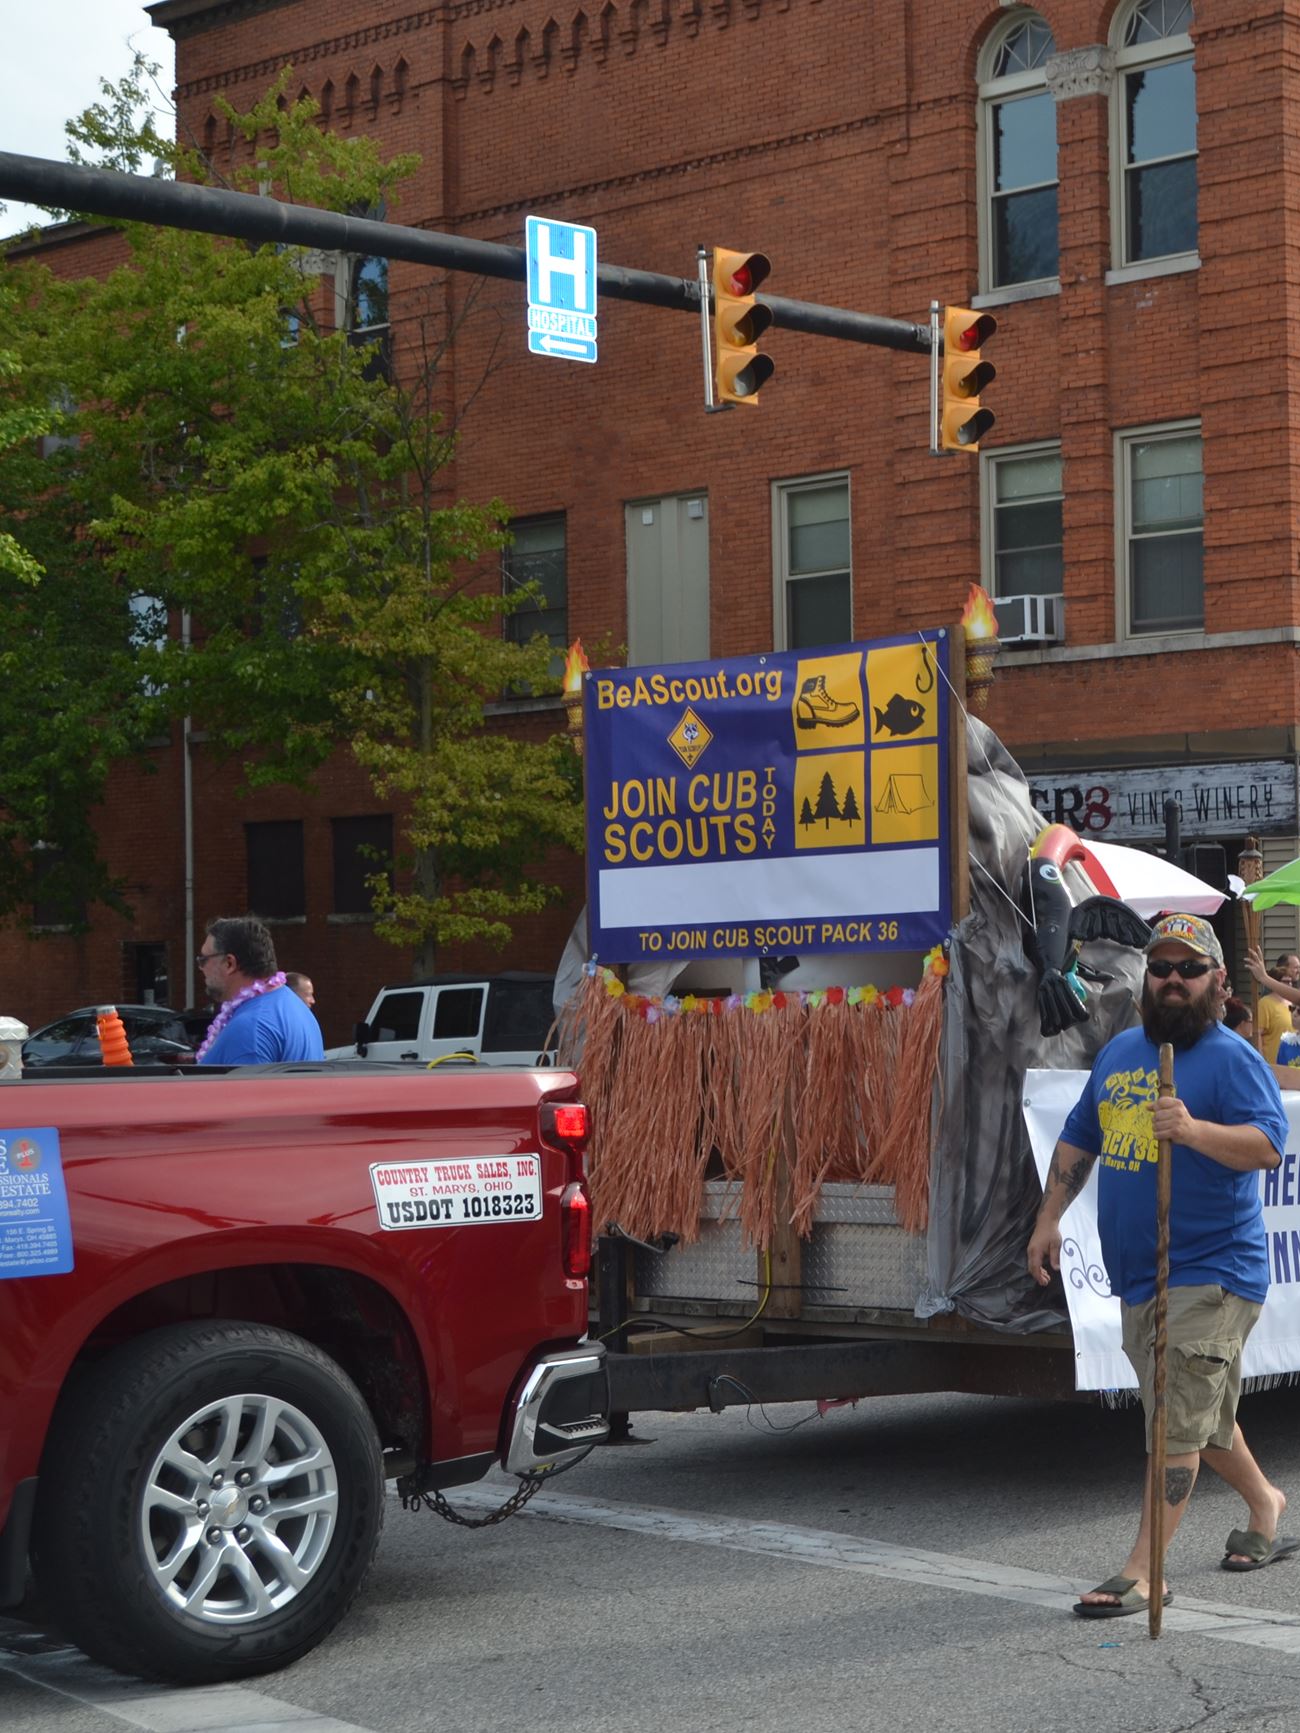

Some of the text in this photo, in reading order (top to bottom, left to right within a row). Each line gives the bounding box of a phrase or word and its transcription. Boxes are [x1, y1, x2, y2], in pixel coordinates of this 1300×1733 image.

[537, 224, 587, 310] H
[532, 309, 594, 337] HOSPITAL
[597, 670, 784, 711] BeAScout.org
[603, 769, 758, 820] JOIN CUB
[761, 766, 778, 851] TODAY
[1194, 783, 1274, 822] WINERY
[604, 814, 758, 864] SCOUTS
[639, 920, 899, 952] TO JOIN CUB SCOUT PACK 36
[376, 1160, 538, 1187] COUNTRY TRUCK SALES, INC.
[1128, 1160, 1141, 1172] OH
[1, 1183, 51, 1197] ESTATE
[409, 1180, 513, 1198] ST. MARYS, OHIO
[387, 1193, 535, 1224] USDOT 1018323
